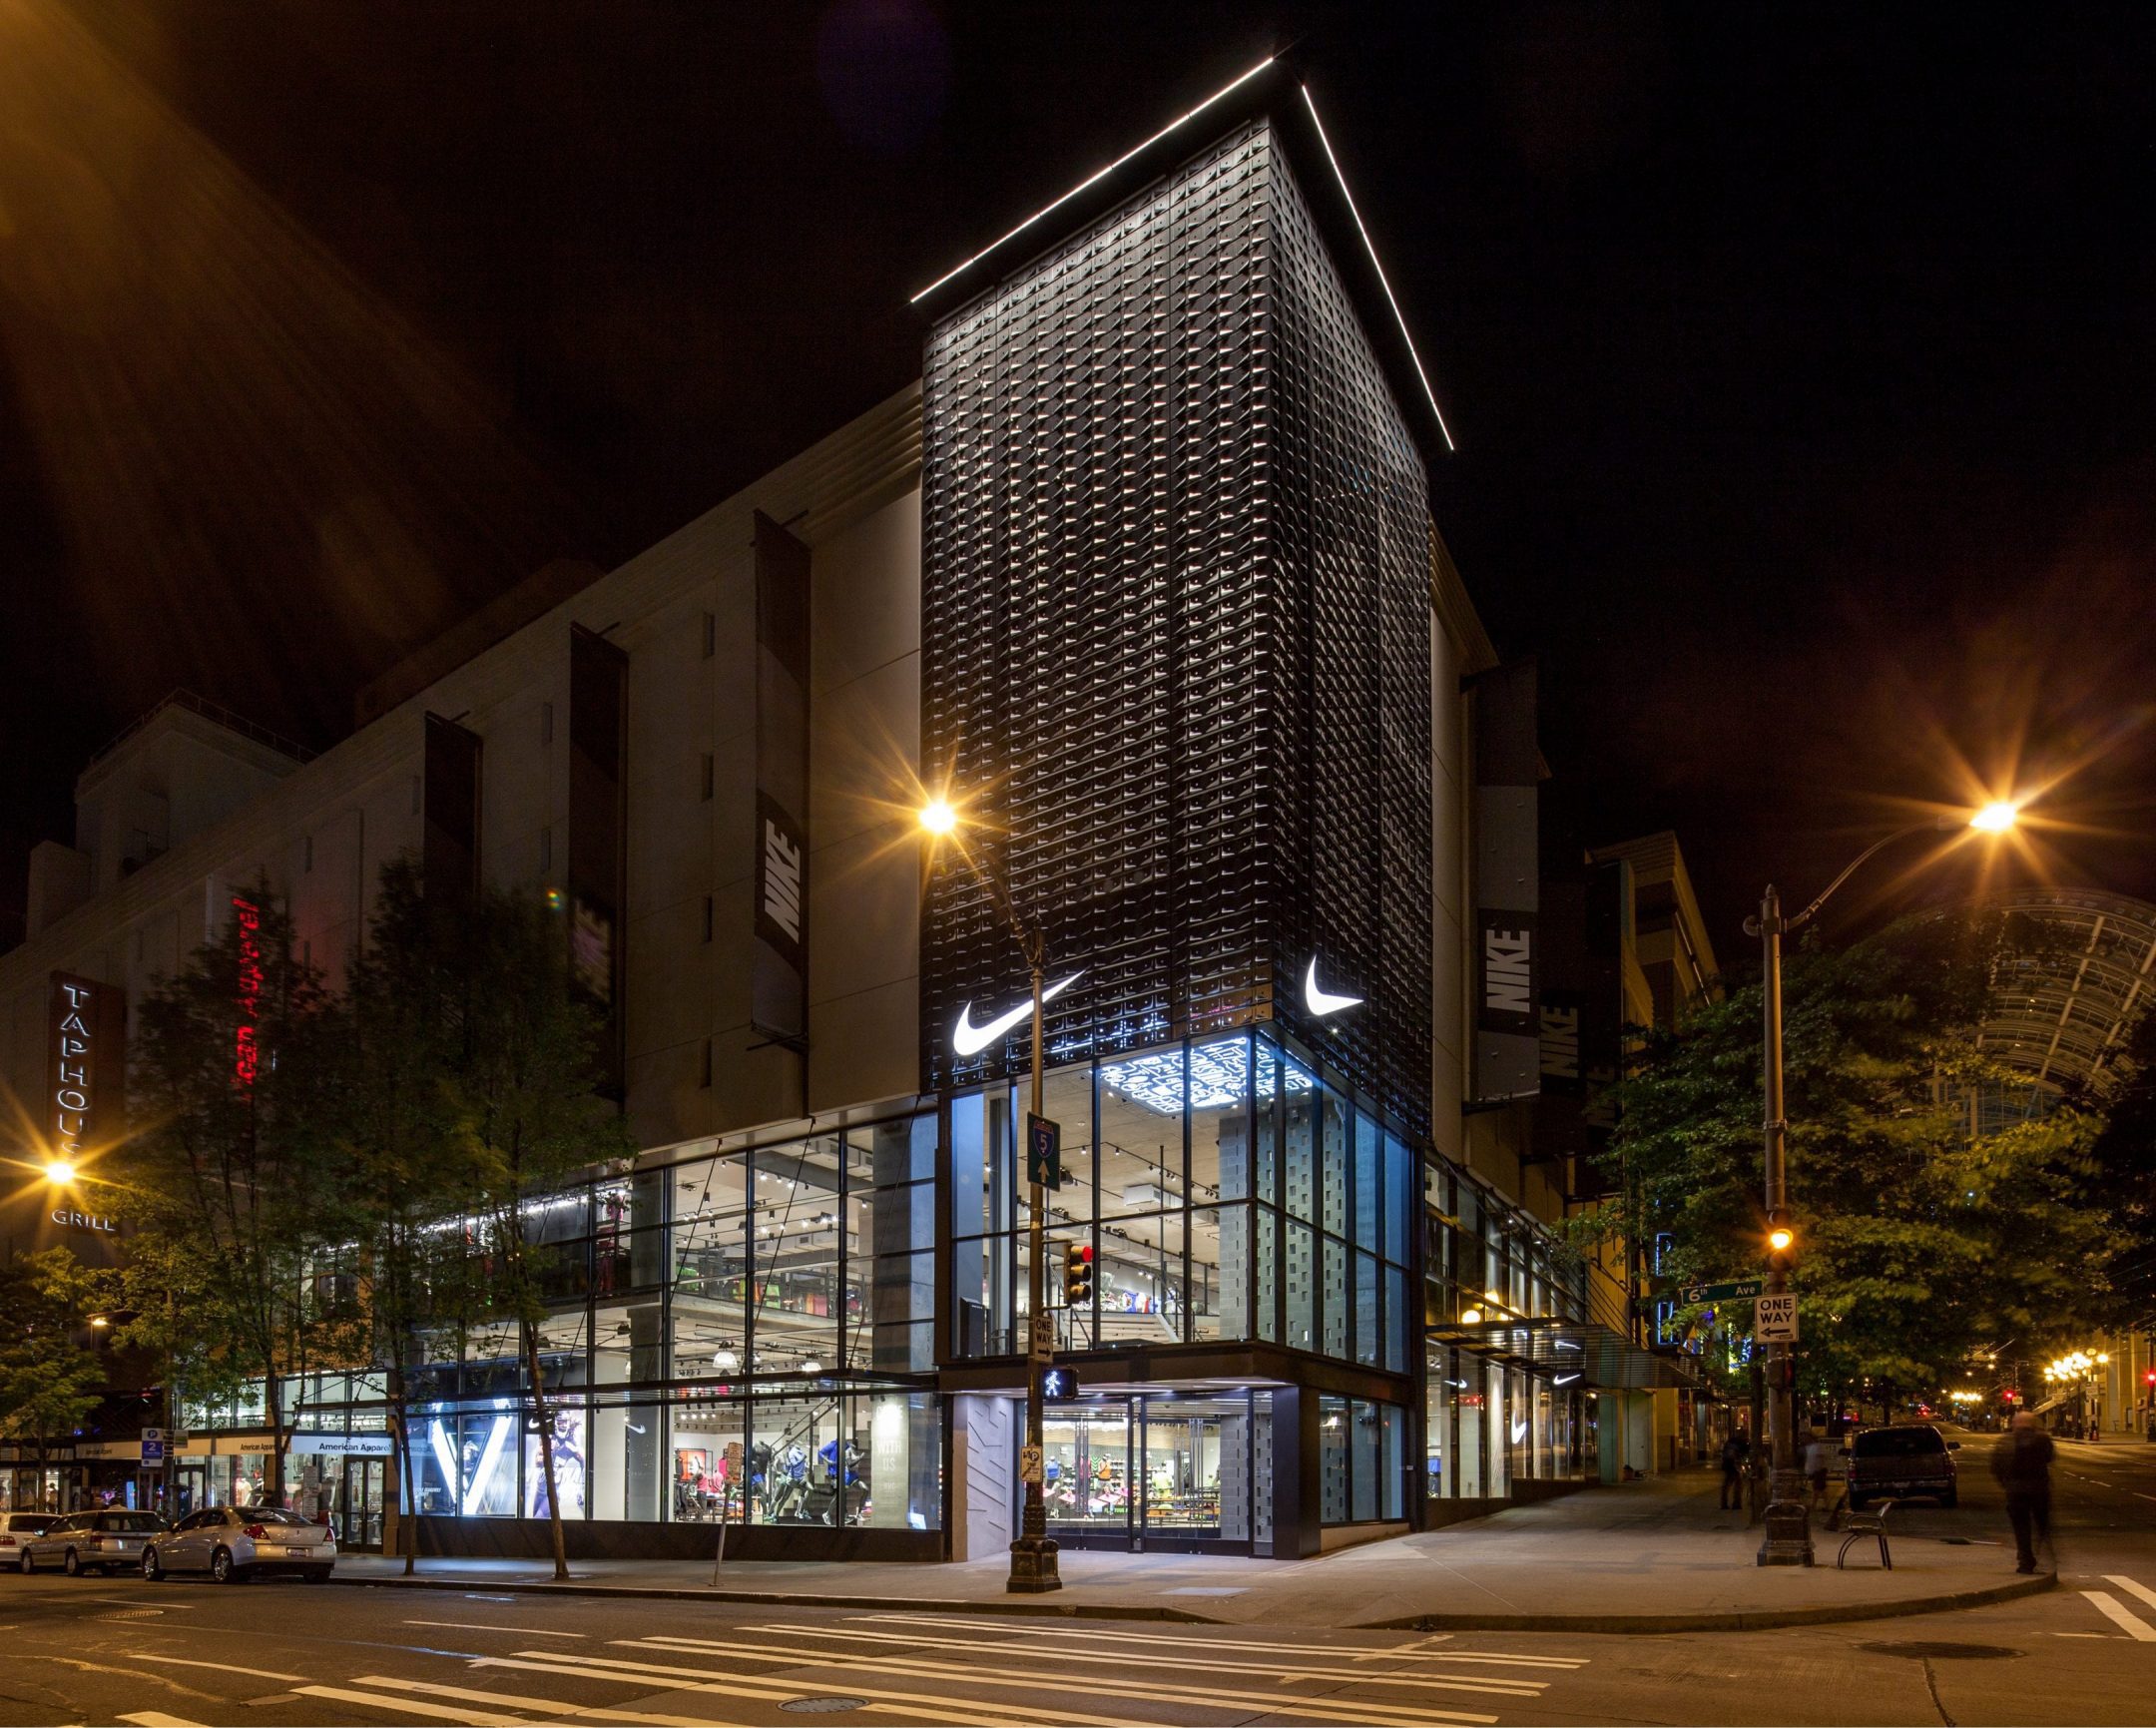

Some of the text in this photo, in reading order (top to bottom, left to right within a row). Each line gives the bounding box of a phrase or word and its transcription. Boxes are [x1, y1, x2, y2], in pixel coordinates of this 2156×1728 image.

[765, 819, 800, 944] NIKE
[1486, 929, 1530, 1013] NIKE
[1539, 1005, 1579, 1079] NIKE
[58, 984, 91, 1156] TAPHOUS
[1040, 1134, 1048, 1150] 5
[52, 1209, 116, 1232] GRILL
[1689, 1286, 1756, 1303] 6th Ave
[1760, 1298, 1792, 1311] ONE
[1760, 1311, 1794, 1324] WAY
[1035, 1319, 1052, 1332] ONE
[1035, 1332, 1052, 1345] WAY
[318, 1442, 358, 1451] American
[878, 1440, 901, 1454] WITH
[882, 1457, 896, 1471] US
